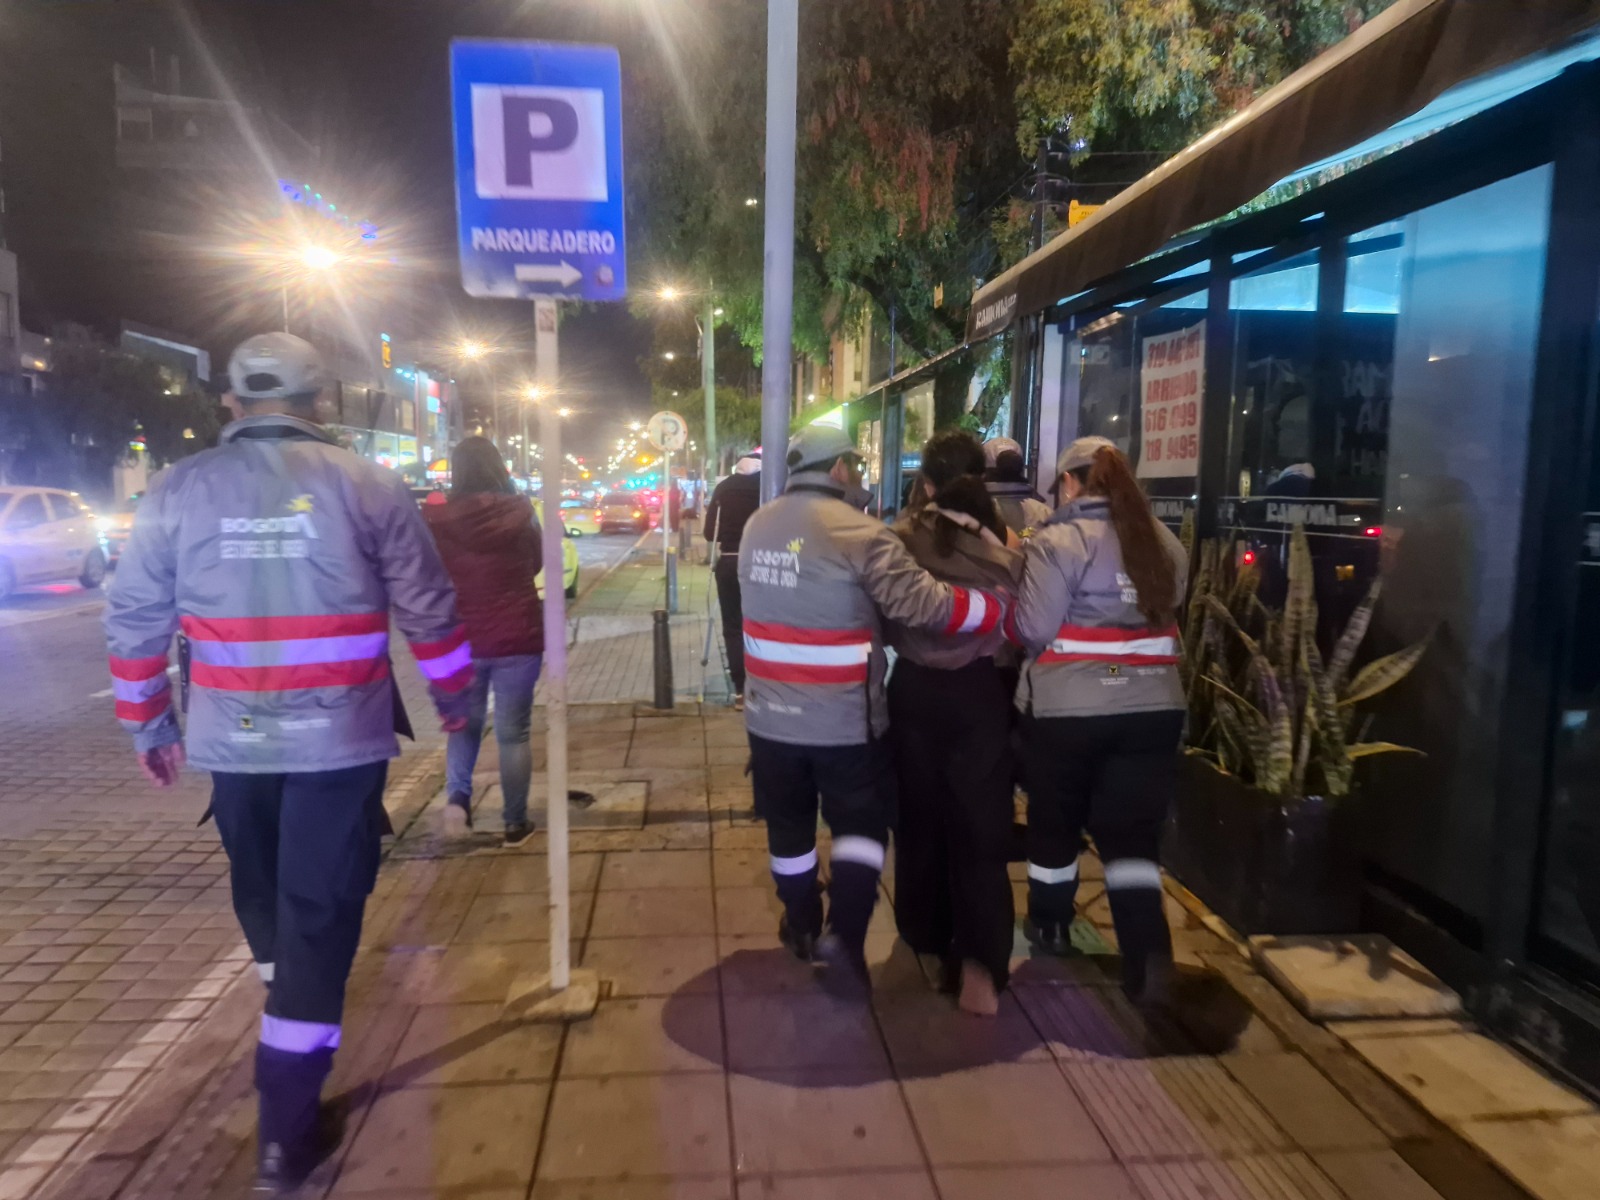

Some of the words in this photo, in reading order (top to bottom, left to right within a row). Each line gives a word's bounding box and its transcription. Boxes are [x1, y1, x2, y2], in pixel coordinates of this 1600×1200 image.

[501, 95, 578, 188] P
[471, 227, 615, 254] PARQUEADERO
[661, 418, 680, 446] P
